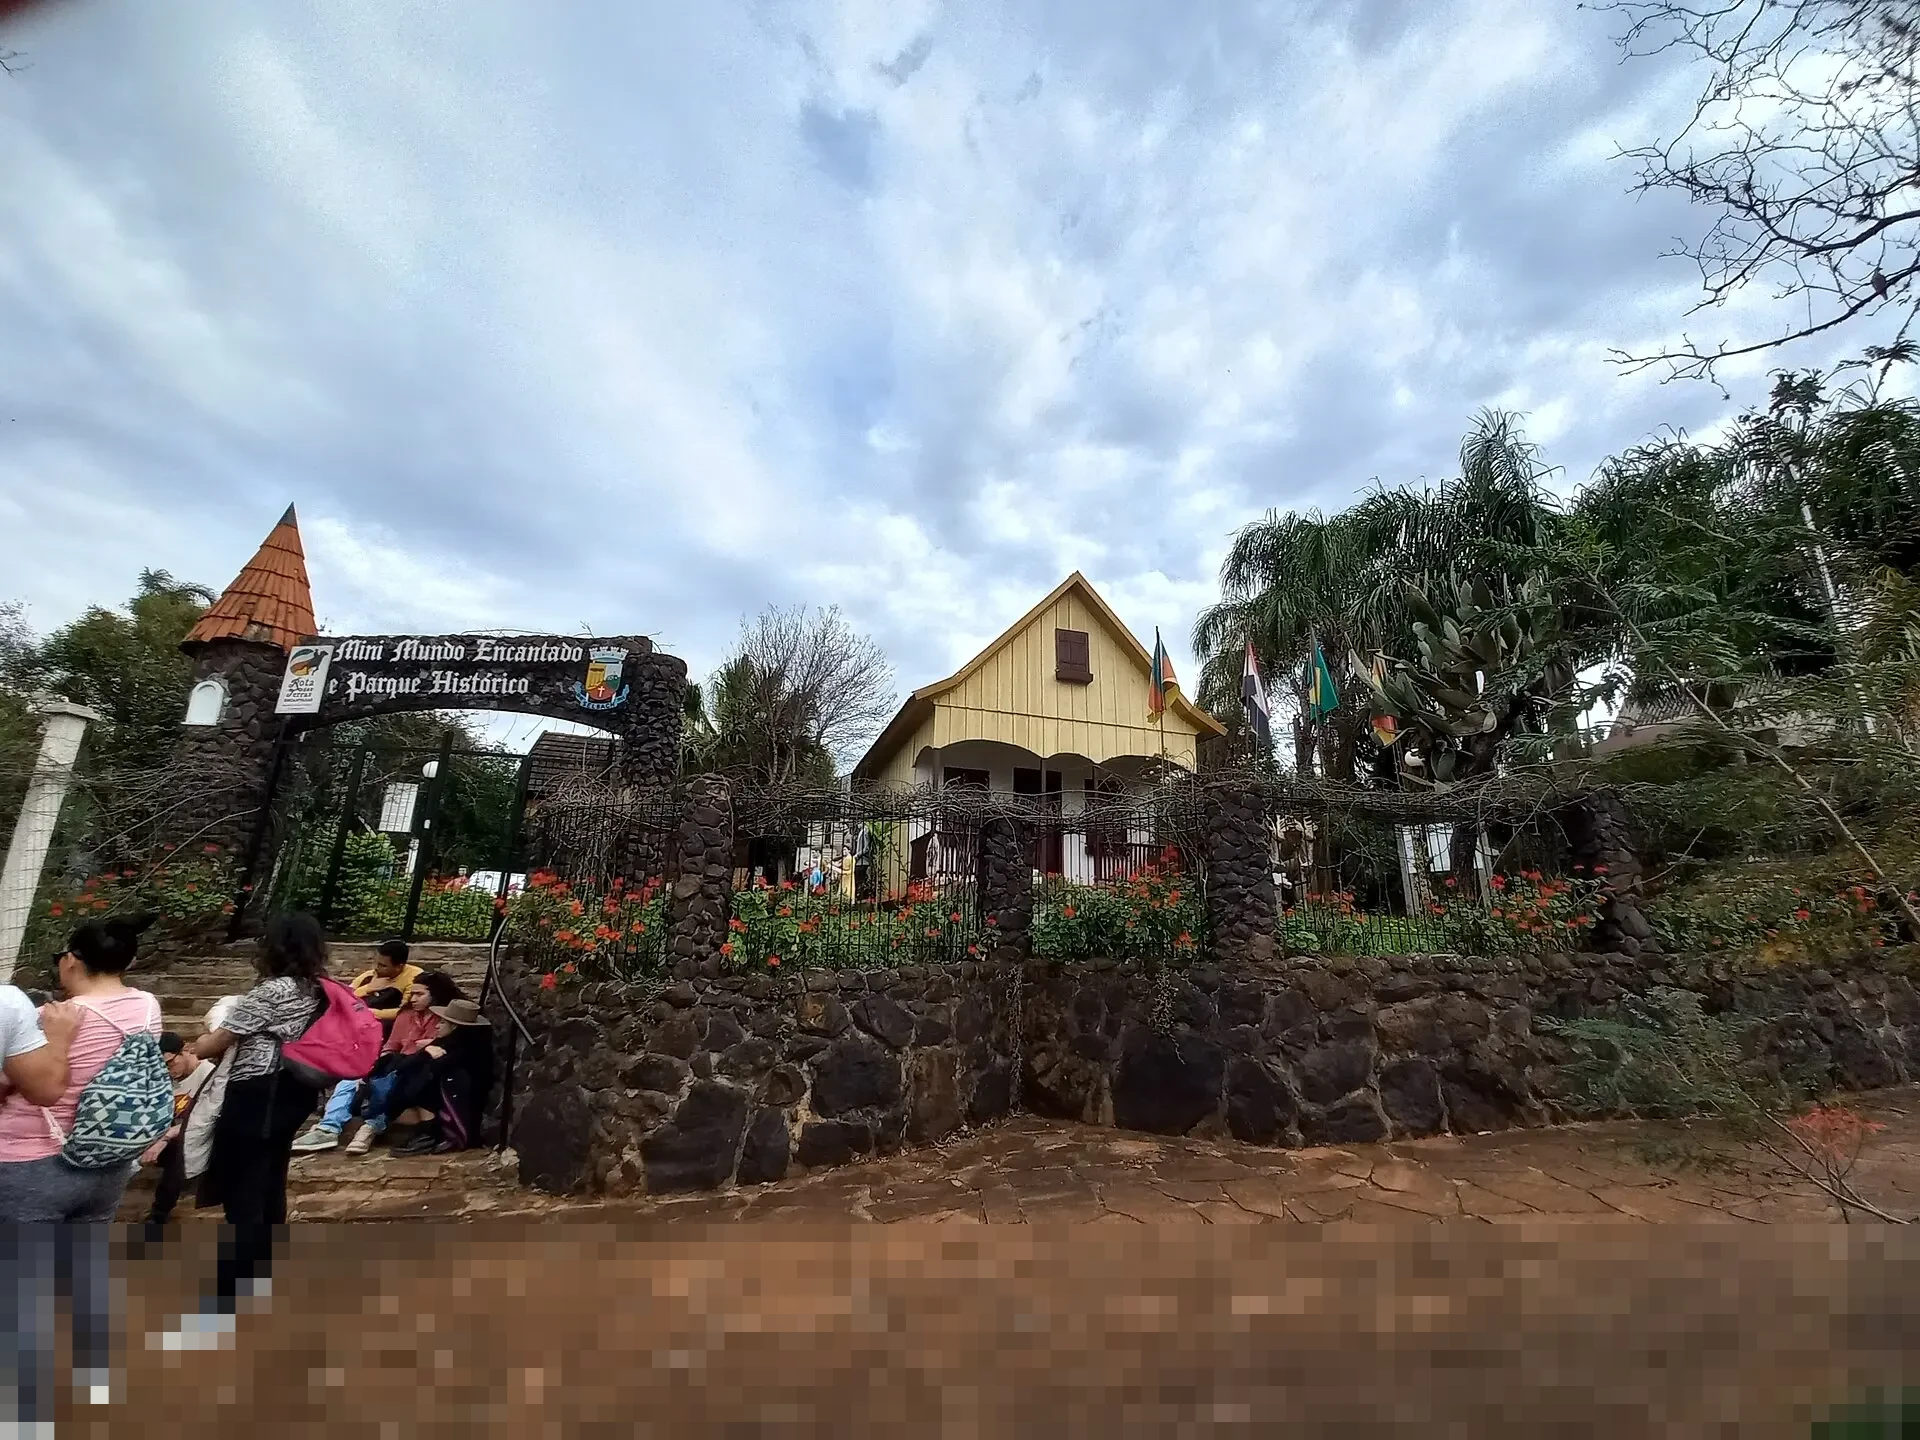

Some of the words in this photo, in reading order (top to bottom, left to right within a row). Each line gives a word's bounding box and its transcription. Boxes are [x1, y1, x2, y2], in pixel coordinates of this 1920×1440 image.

[332, 640, 384, 662] Mini
[389, 640, 465, 662] Mundo
[472, 639, 583, 662] Encantado
[328, 678, 338, 695] e
[346, 671, 421, 702] Parque
[428, 670, 529, 695] Histórico
